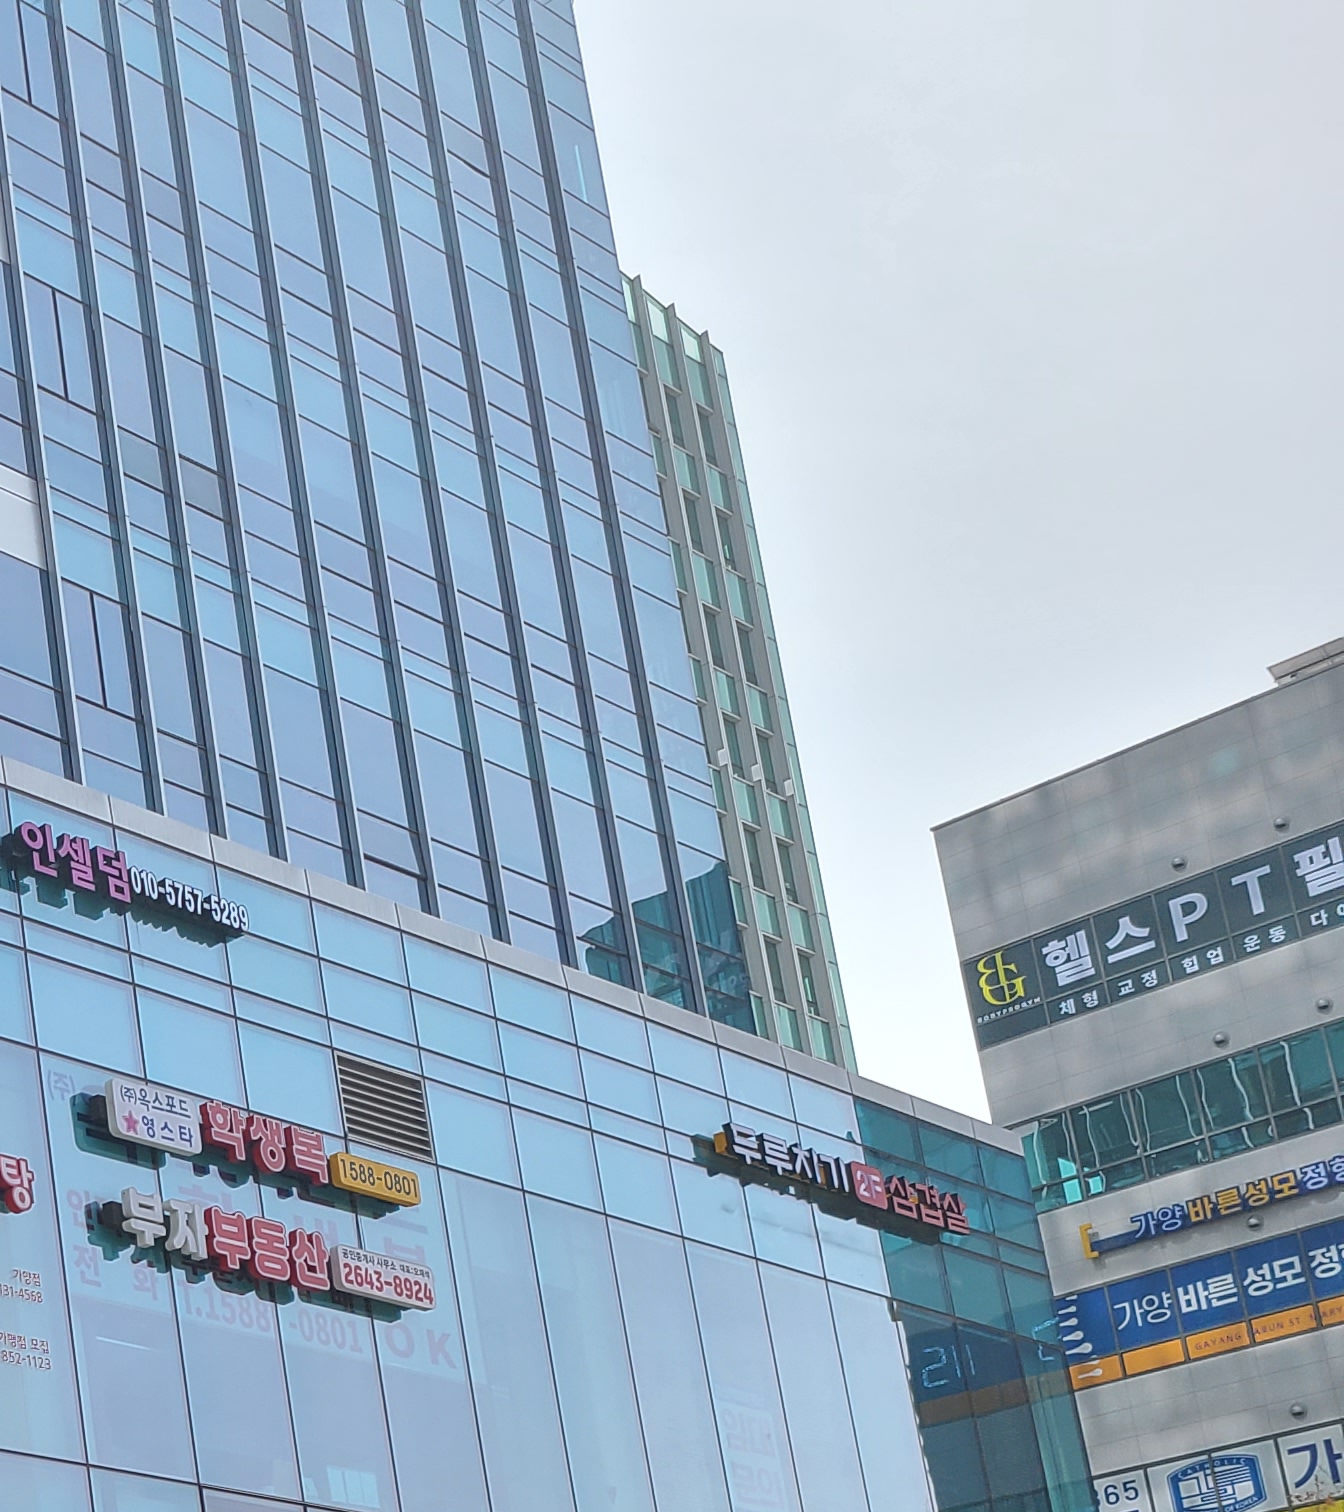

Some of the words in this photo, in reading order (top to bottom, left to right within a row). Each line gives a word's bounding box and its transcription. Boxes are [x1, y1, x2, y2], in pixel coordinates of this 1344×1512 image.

[20, 820, 133, 903] 인셀덤
[130, 865, 250, 932] 010-5757-5289
[119, 1082, 192, 1120] (주)옥스포드
[210, 1099, 329, 1186] 학생복
[731, 1122, 851, 1194] 두루치기
[339, 1156, 420, 1199] 1588-0801
[11, 1268, 42, 1288] 가양점
[341, 1247, 376, 1266] 공인중개사
[376, 1256, 398, 1272] 사무소
[342, 1261, 434, 1306] 2643-8924
[30, 1338, 50, 1355] 모집
[1251, 1321, 1285, 1337] ARUN
